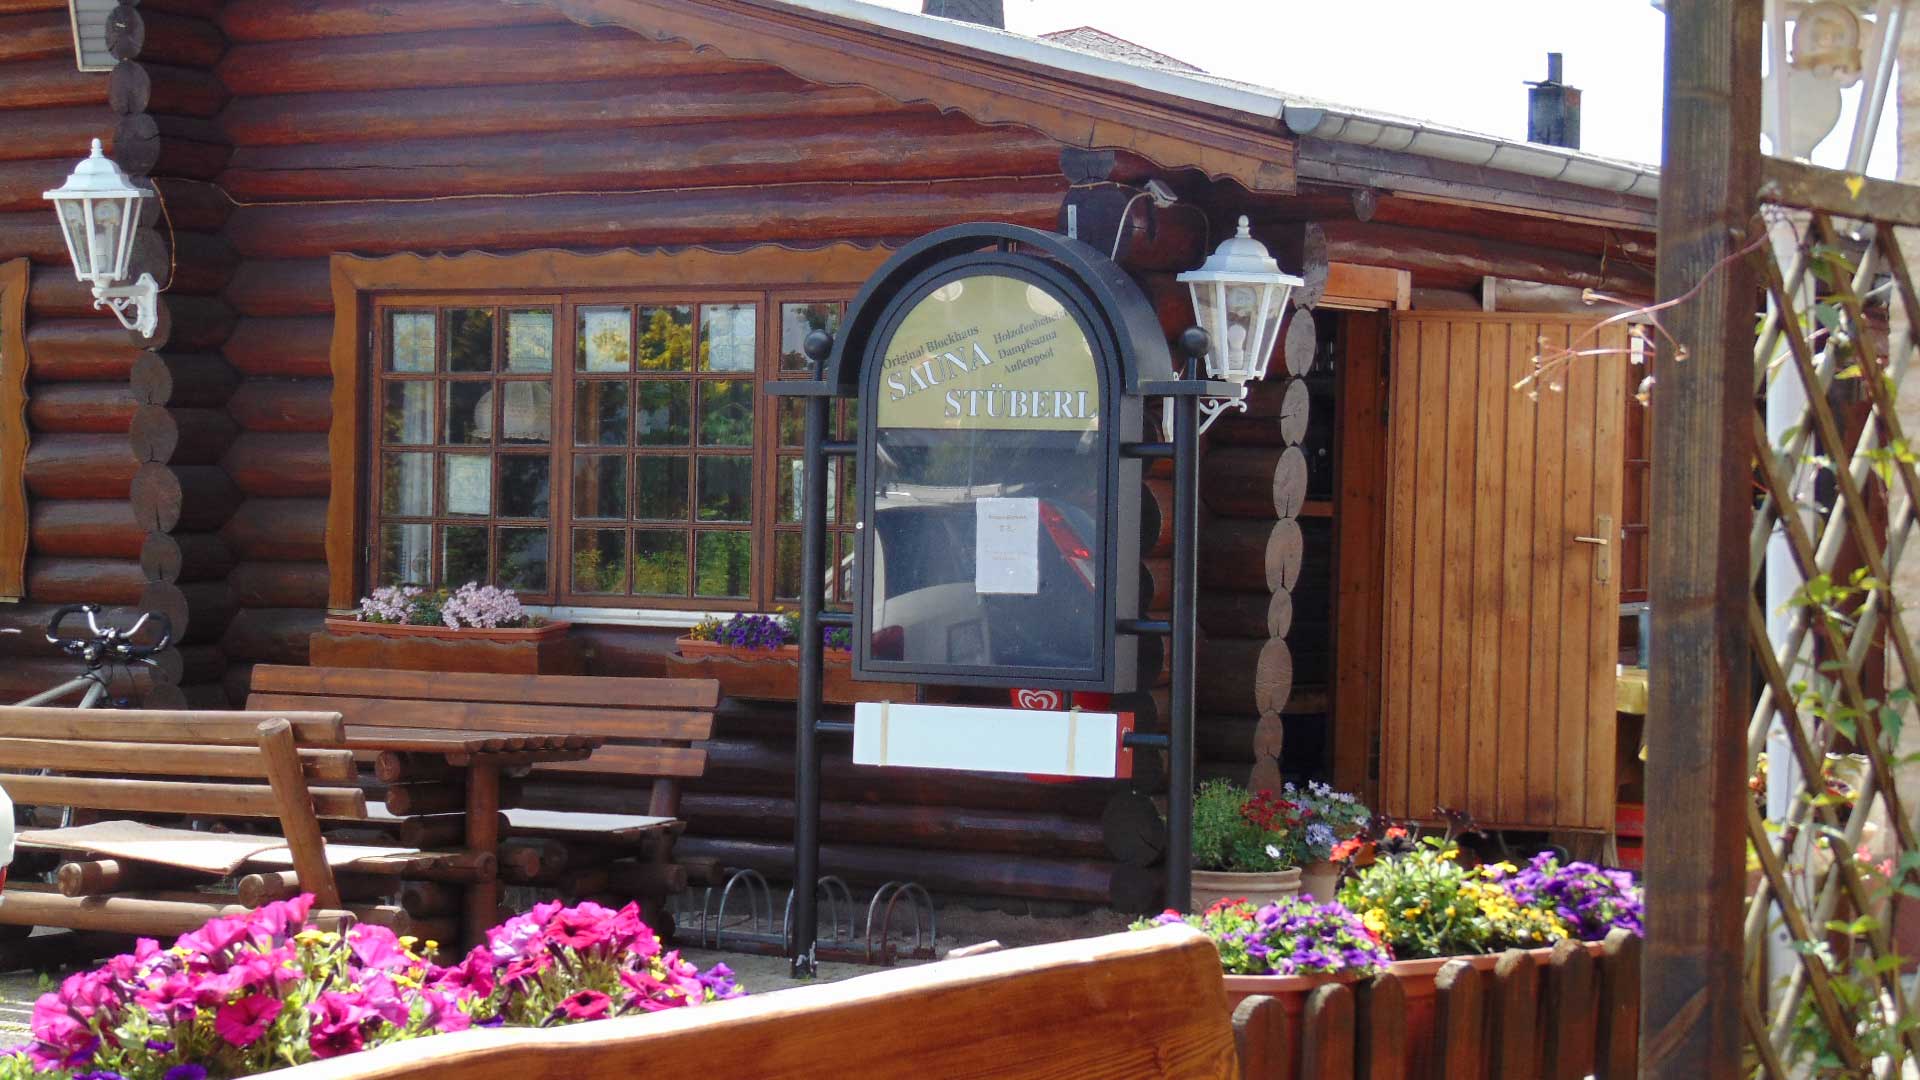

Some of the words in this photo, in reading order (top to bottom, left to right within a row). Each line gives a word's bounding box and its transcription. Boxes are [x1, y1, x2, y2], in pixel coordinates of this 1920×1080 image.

[883, 345, 925, 370] Original
[926, 326, 979, 353] Blockhaus
[998, 330, 1057, 360] Dampfsauna
[887, 342, 993, 402] SAUNA
[944, 383, 1098, 419] STÜBERL
